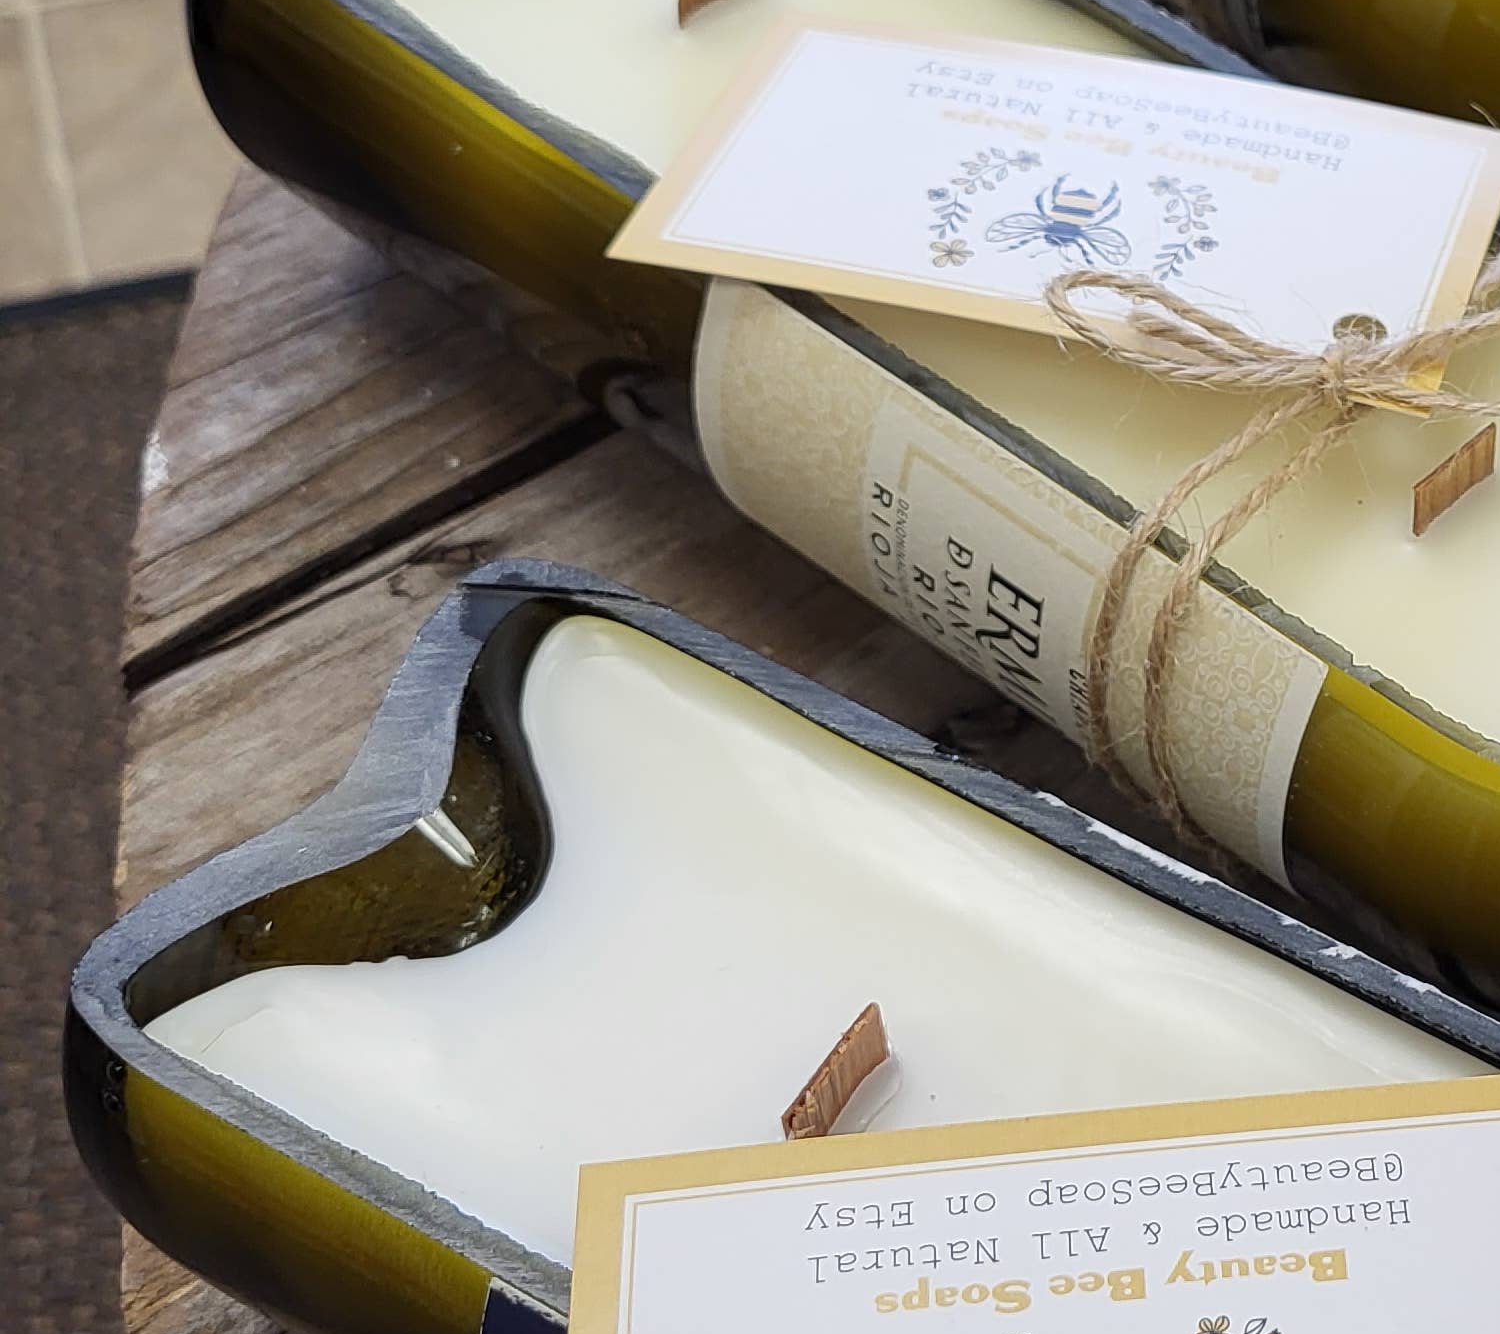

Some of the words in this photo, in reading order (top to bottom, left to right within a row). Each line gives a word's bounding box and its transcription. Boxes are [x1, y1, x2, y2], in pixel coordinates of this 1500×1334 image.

[918, 61, 995, 88] Etsy
[1017, 77, 1055, 93] on
[906, 82, 1042, 117] Natural
[941, 107, 1051, 142] Soaps
[1066, 107, 1124, 131] All
[1075, 86, 1351, 151] @BeautyBeeSoap
[1144, 122, 1160, 135] &
[1064, 127, 1134, 158] Bee
[1184, 128, 1343, 173] Handmade
[871, 481, 898, 597] RIOJA
[976, 563, 1057, 725] ERMI
[1029, 1153, 1404, 1207] @BeautyBeeSoap
[804, 1199, 915, 1233] Etsy
[945, 1191, 996, 1216] on
[1196, 1198, 1412, 1240] Handmade
[1032, 1225, 1110, 1260] All
[1143, 1221, 1162, 1247] &
[807, 1236, 998, 1285] Natural
[1164, 1247, 1349, 1287] Beauty
[875, 1275, 1032, 1315] Soaps
[1050, 1267, 1147, 1302] Bee
